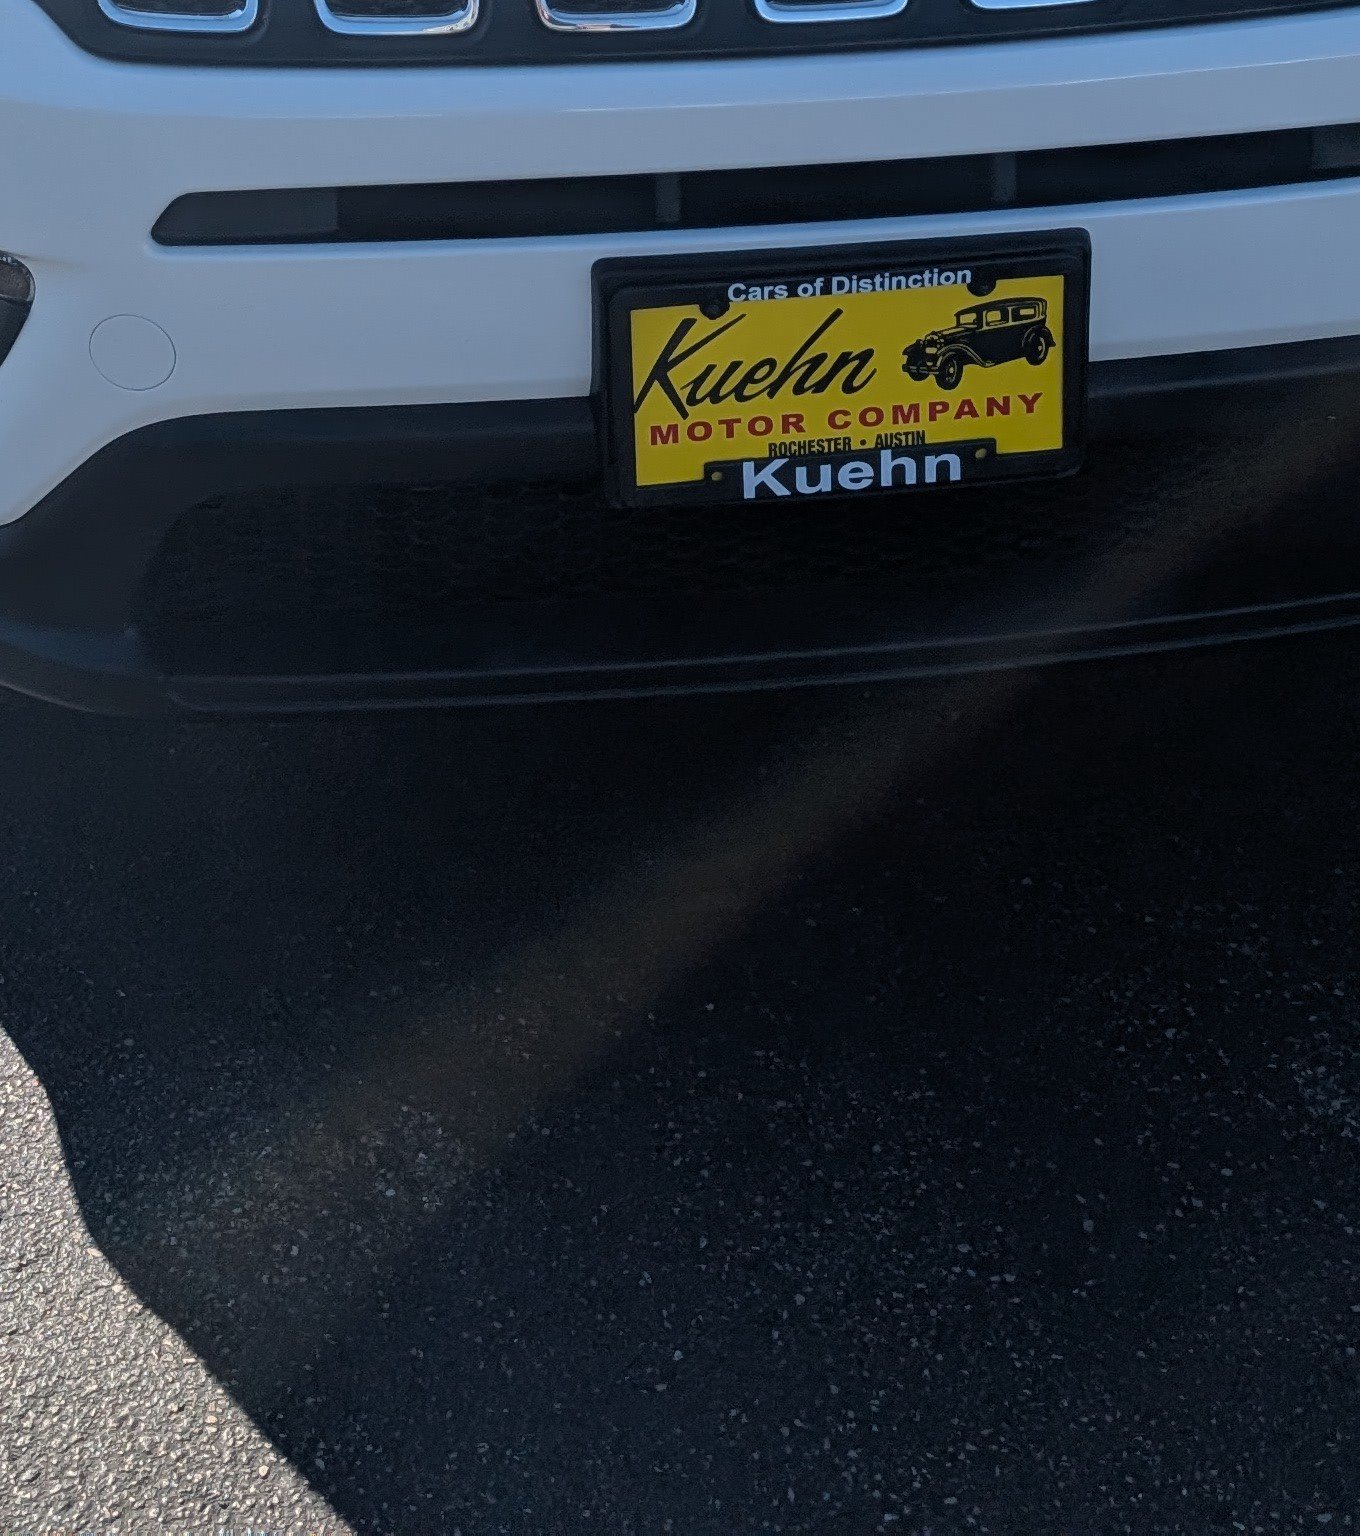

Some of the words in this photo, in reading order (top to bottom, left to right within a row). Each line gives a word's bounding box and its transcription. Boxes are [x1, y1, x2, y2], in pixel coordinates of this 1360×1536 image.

[727, 282, 789, 303] Cars
[797, 277, 825, 298] of
[831, 268, 972, 296] Distinction
[633, 307, 878, 421] Kuehn
[650, 413, 806, 446] MOTOR
[827, 392, 1044, 431] COMPANY
[767, 436, 852, 458] ROCHESTER
[874, 430, 926, 449] AUSTIN
[742, 449, 962, 500] Kuehn
